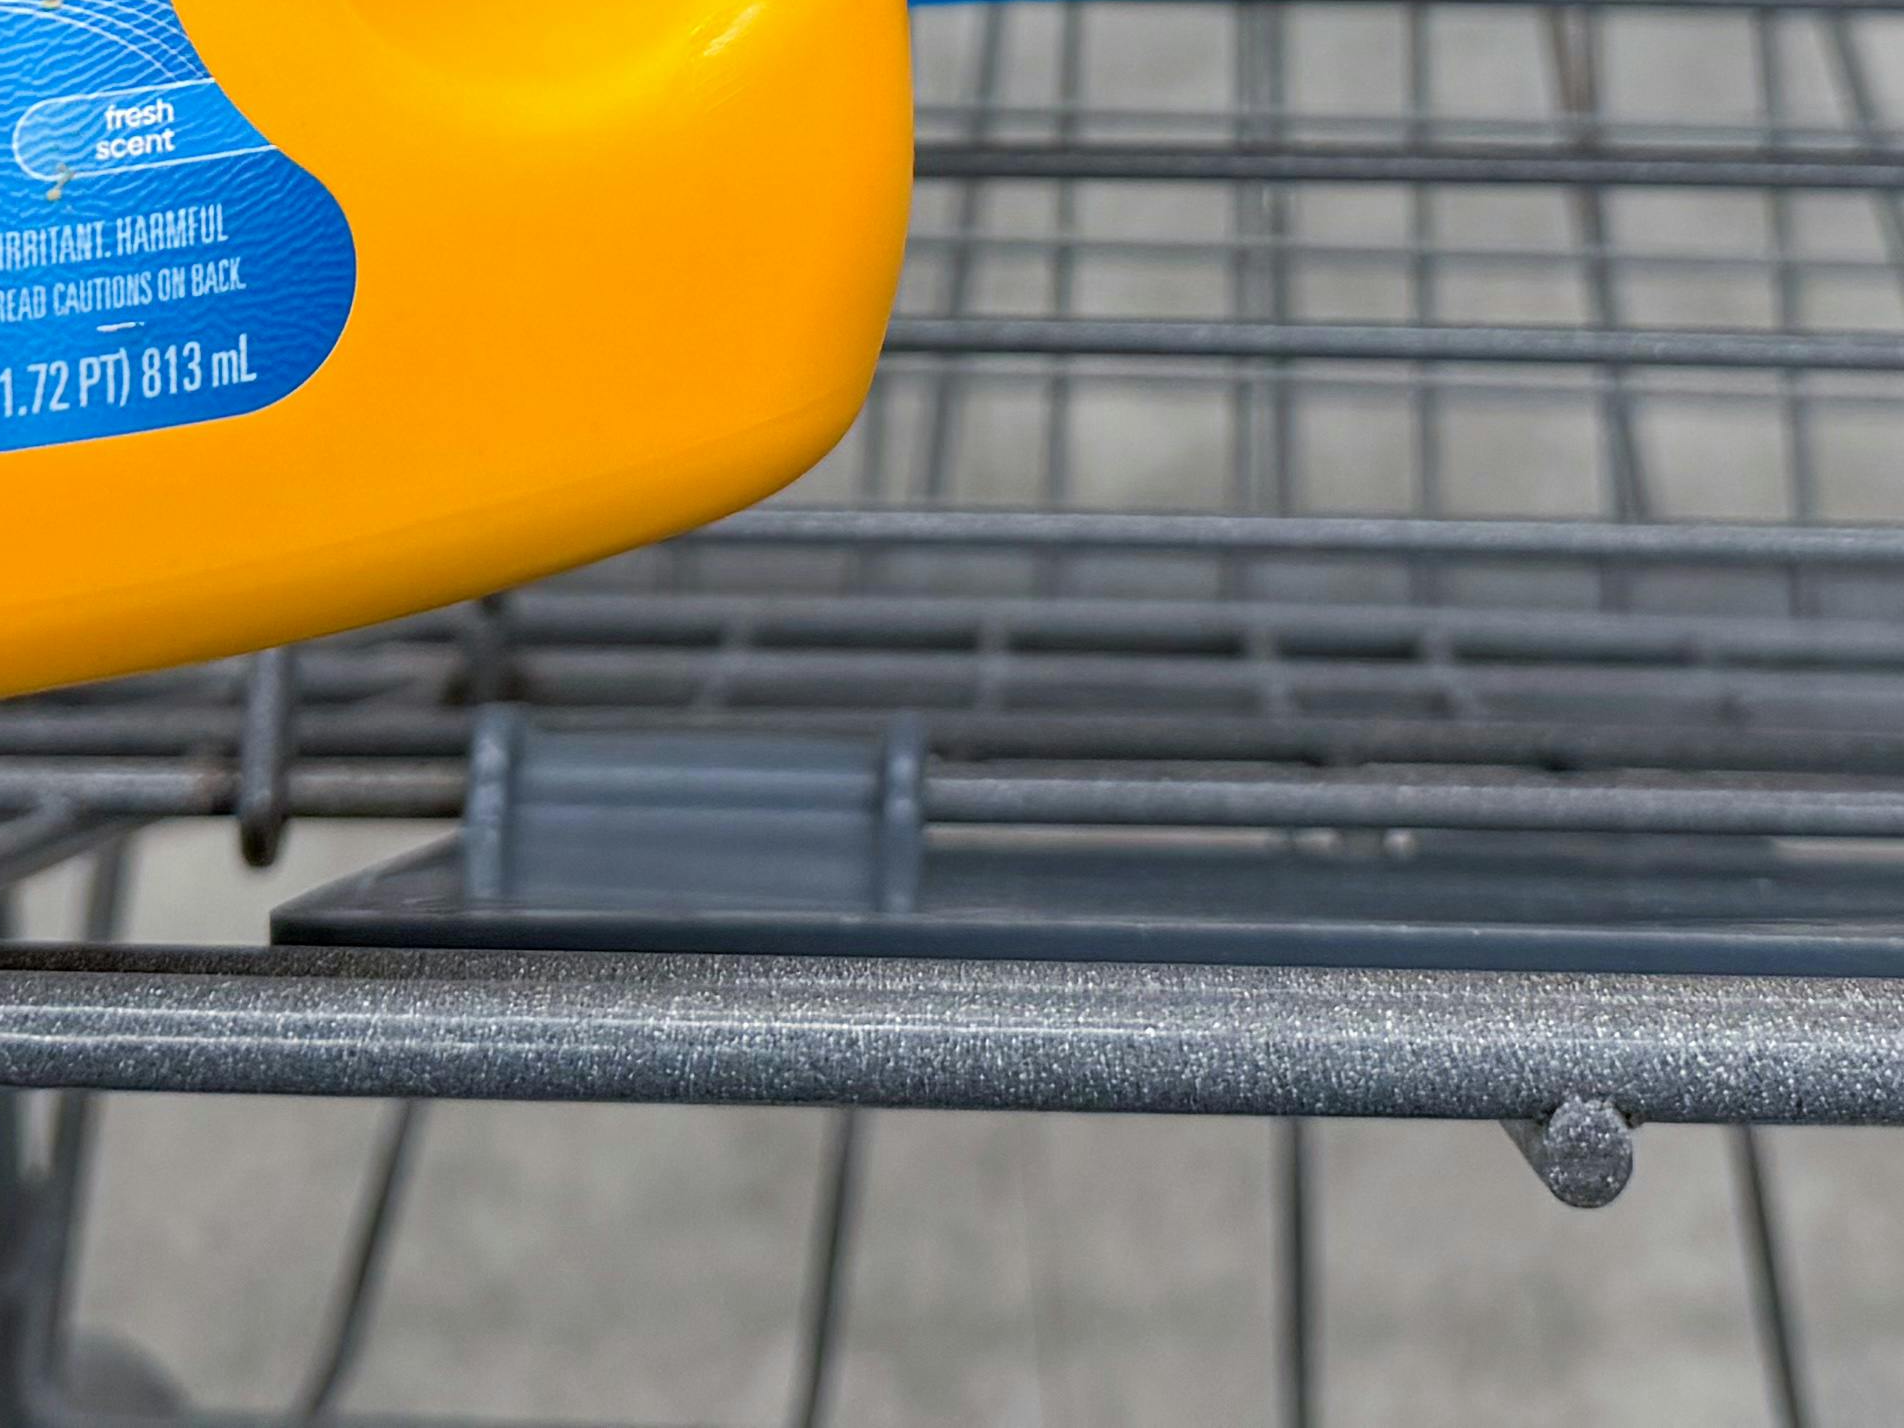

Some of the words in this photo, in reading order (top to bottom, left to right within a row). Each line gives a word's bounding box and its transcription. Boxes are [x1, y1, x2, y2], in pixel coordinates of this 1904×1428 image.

[105, 98, 174, 131] fresh
[96, 129, 175, 162] scent
[116, 202, 229, 257] HARMFUL
[53, 271, 152, 315] CAUTIONS
[158, 267, 185, 302] ON
[190, 256, 247, 296] BACK.
[78, 346, 131, 407] PT)
[141, 340, 202, 400] 813
[211, 332, 258, 385] mL
